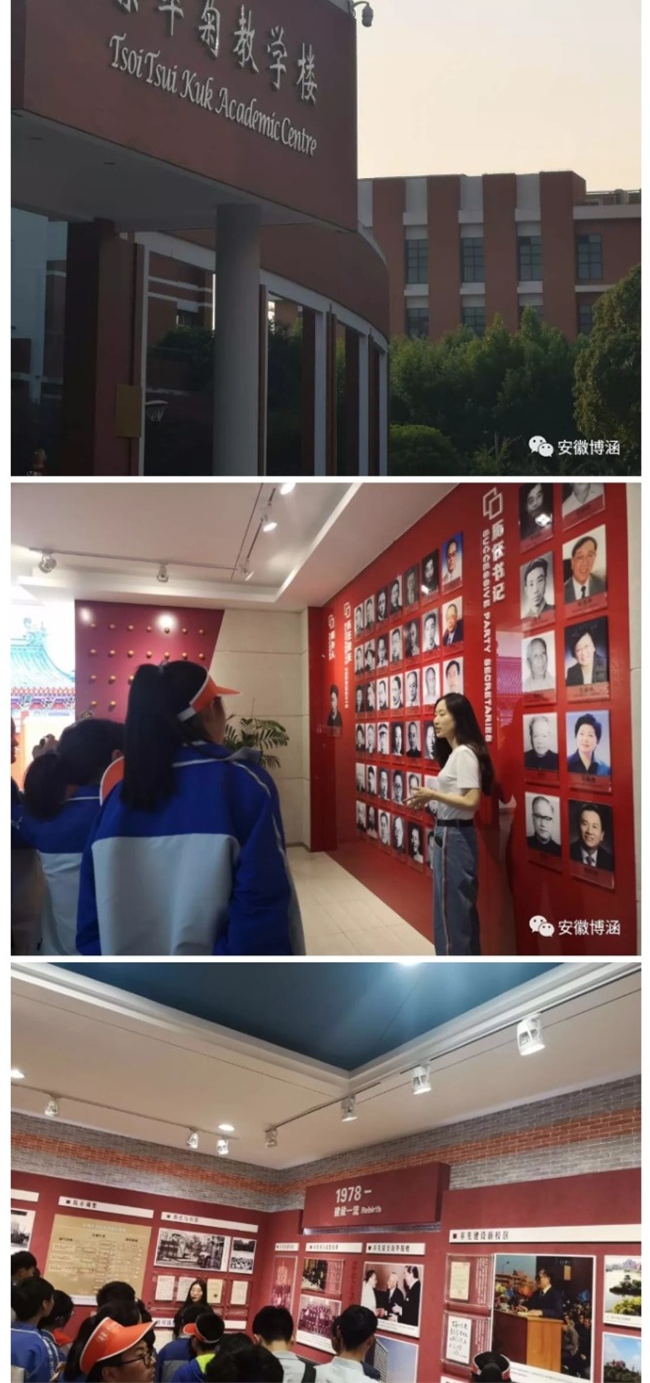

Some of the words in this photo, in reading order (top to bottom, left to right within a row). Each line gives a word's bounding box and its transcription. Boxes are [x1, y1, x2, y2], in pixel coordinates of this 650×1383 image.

[109, 32, 143, 79] Tsoi
[144, 50, 178, 94] Tsui
[180, 69, 214, 112] Kuk
[215, 87, 281, 142] Academic
[281, 117, 317, 157] Centre
[483, 611, 492, 654] PARTY
